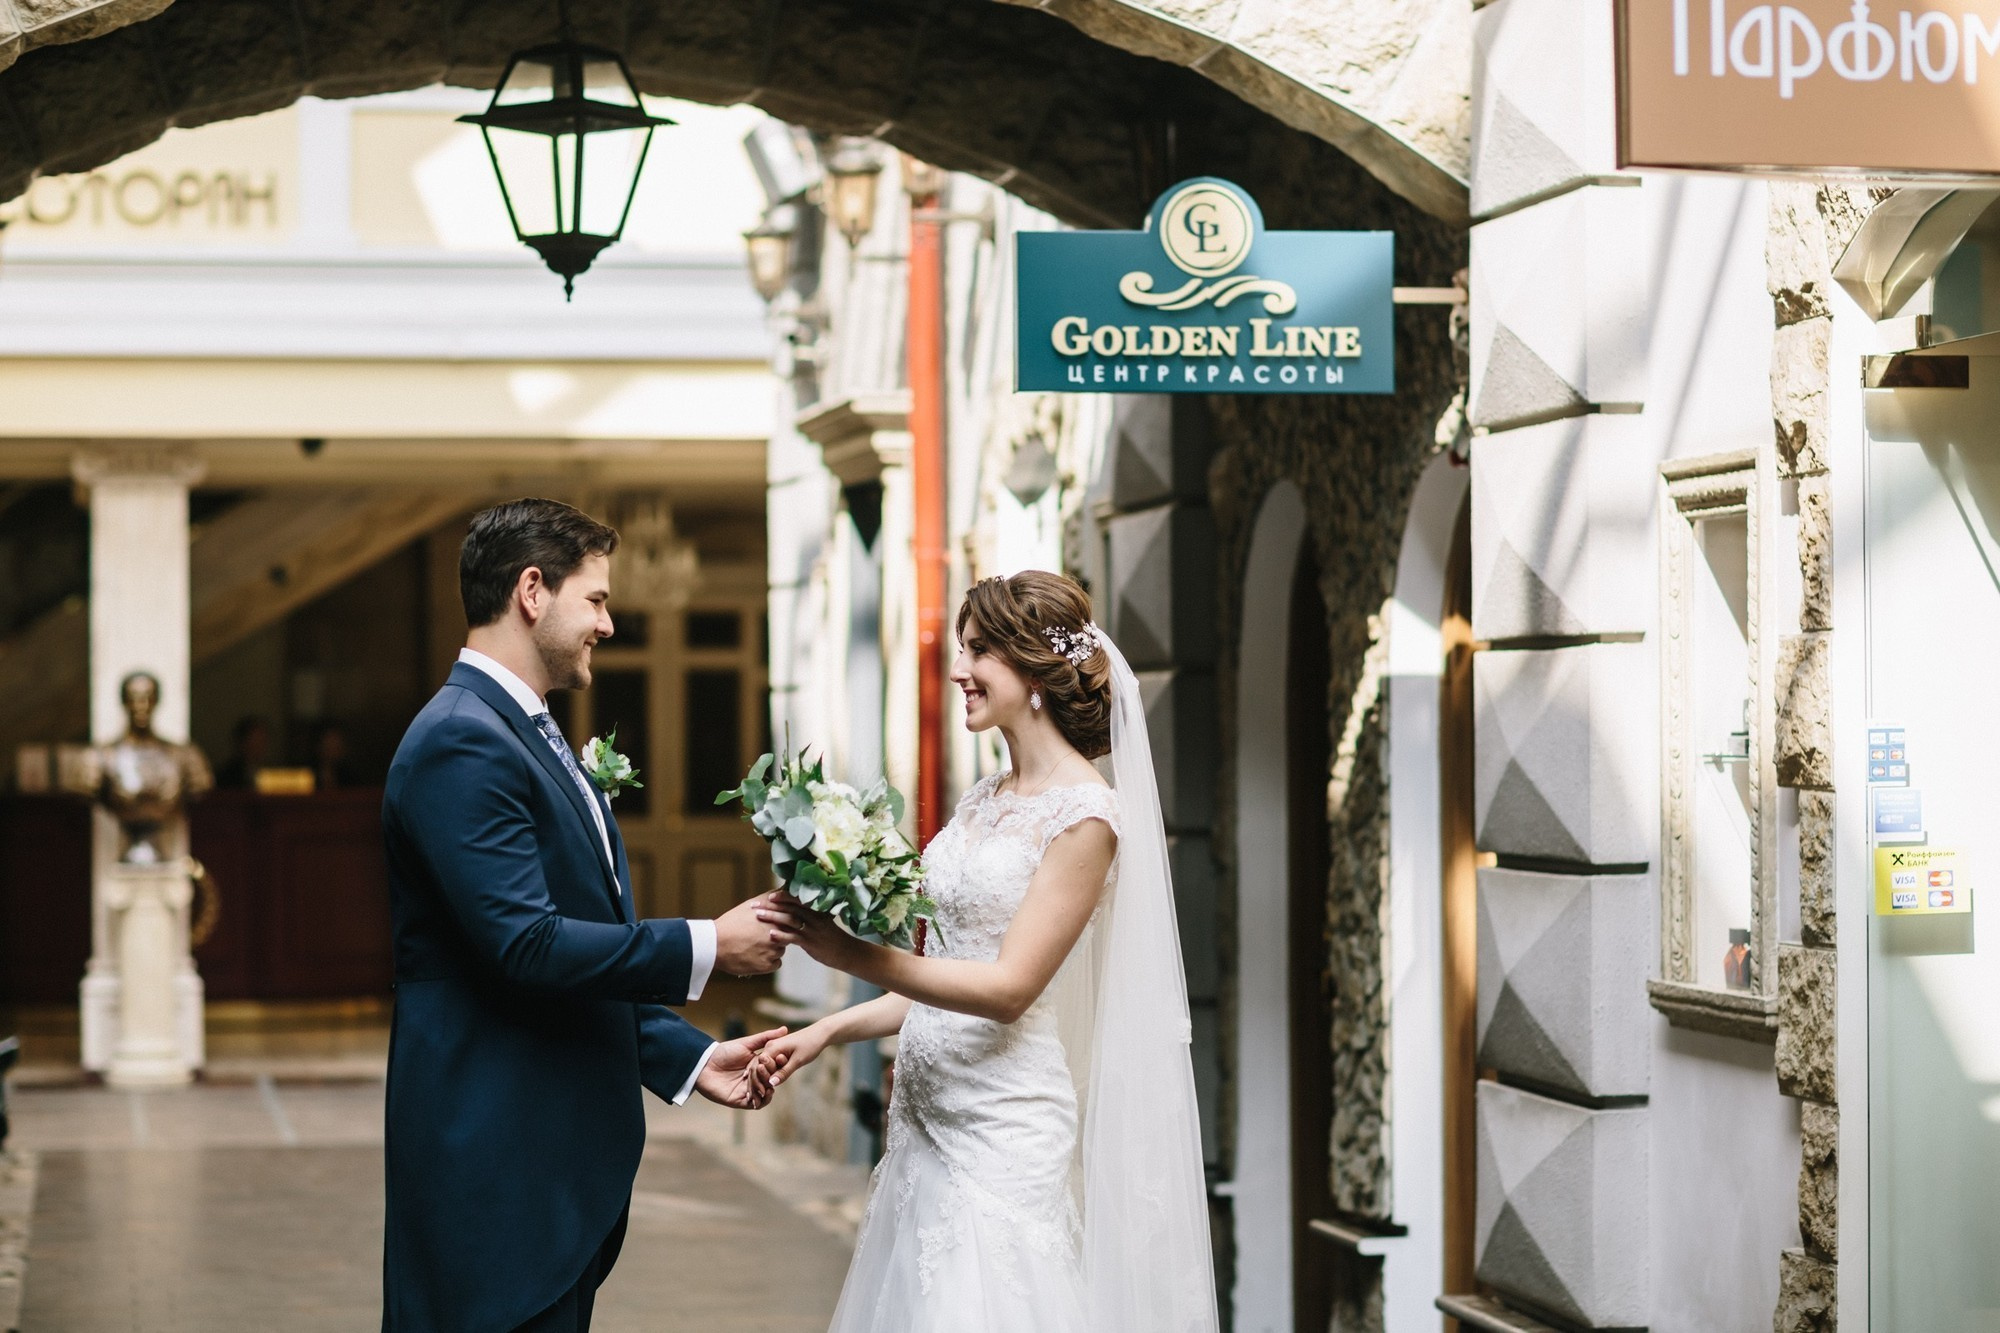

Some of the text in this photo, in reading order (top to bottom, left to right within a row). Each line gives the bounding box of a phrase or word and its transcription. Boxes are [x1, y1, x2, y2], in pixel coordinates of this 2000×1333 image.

[1067, 365, 1344, 385] ЦЕНТР КРАСОТЫ
[1894, 876, 1916, 885] VISA
[1895, 894, 1917, 903] VISA
